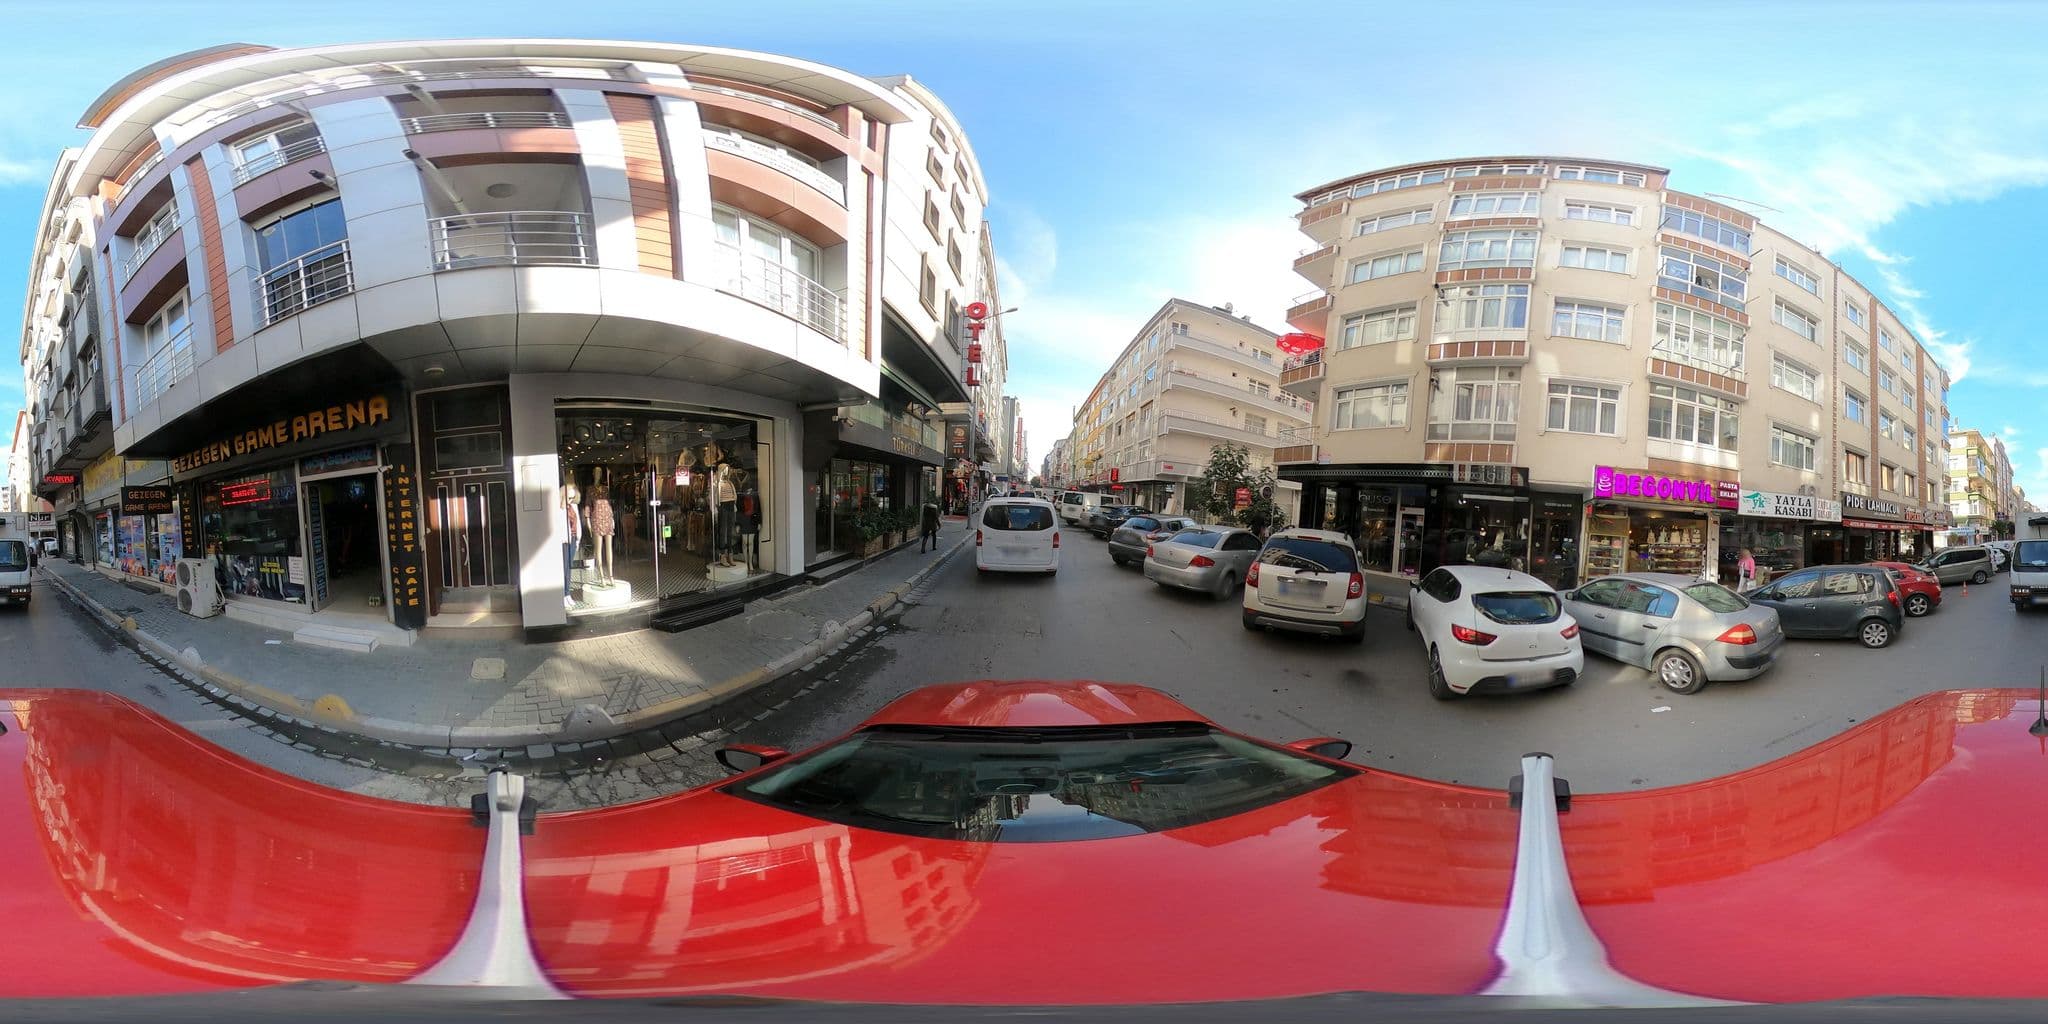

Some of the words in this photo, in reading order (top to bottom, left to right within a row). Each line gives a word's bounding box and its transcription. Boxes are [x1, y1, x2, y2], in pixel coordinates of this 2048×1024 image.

[966, 302, 987, 386] OTEL
[172, 439, 230, 473] GEZEGEN
[234, 420, 289, 455] GAME
[292, 397, 389, 443] ARENA
[1614, 473, 1715, 504] BEGONVİL
[1719, 481, 1738, 490] PASTA
[128, 490, 166, 500] GEZEGEN
[1719, 490, 1738, 499] EKLER
[125, 503, 145, 511] GAME
[148, 502, 171, 511] ARENA
[398, 464, 414, 552] INTERNET
[1775, 495, 1812, 508] YAYLA
[1846, 495, 1864, 508] PİDE
[1774, 506, 1812, 518] KASABI
[405, 566, 419, 607] CAFE
